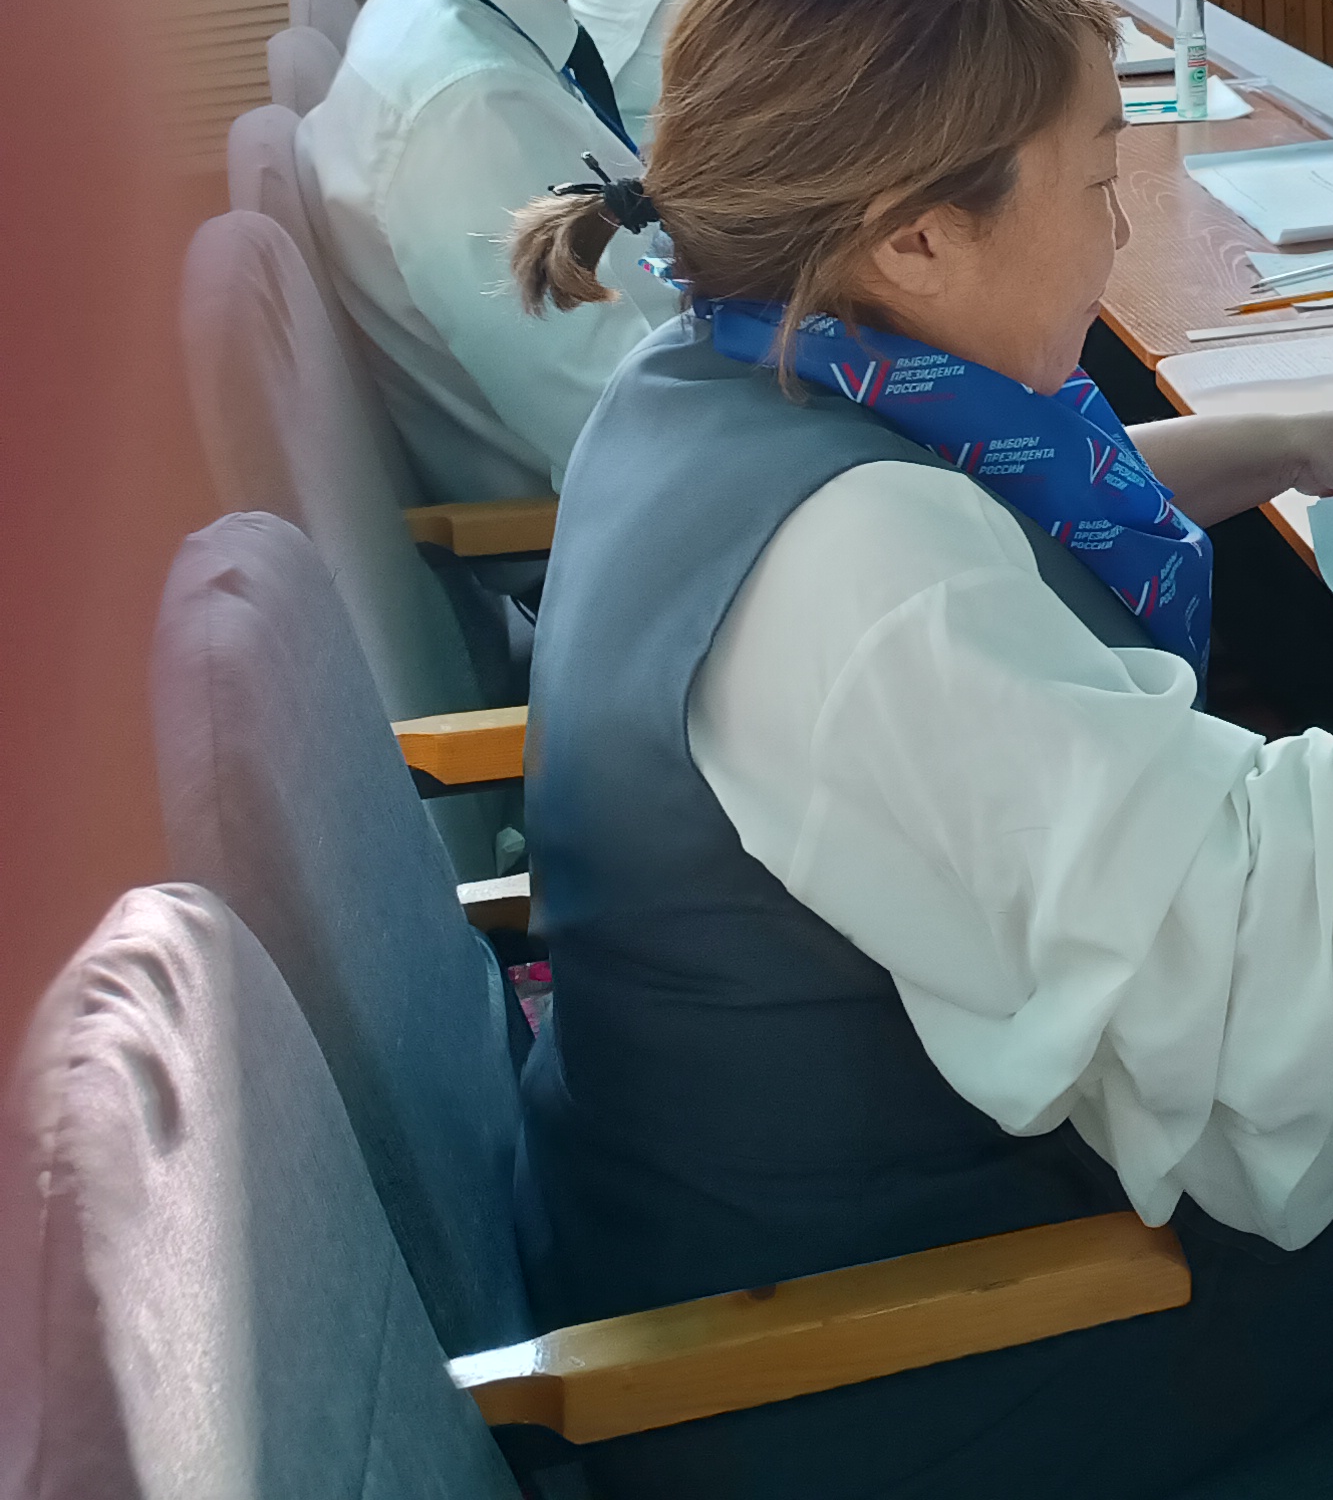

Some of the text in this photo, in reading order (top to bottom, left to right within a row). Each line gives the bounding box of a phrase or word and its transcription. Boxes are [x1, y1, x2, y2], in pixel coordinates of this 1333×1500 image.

[895, 354, 949, 369] ВЫБОРЫ
[890, 365, 965, 382] ПРЕЗИДЕНТА
[885, 381, 934, 396] РОССИИ
[988, 436, 1040, 450] ВЫБОРЫ
[984, 448, 1055, 463] ПРЕЗИДЕНТА
[978, 463, 1026, 475] РОССИИ
[1071, 540, 1113, 550] РОССИИ
